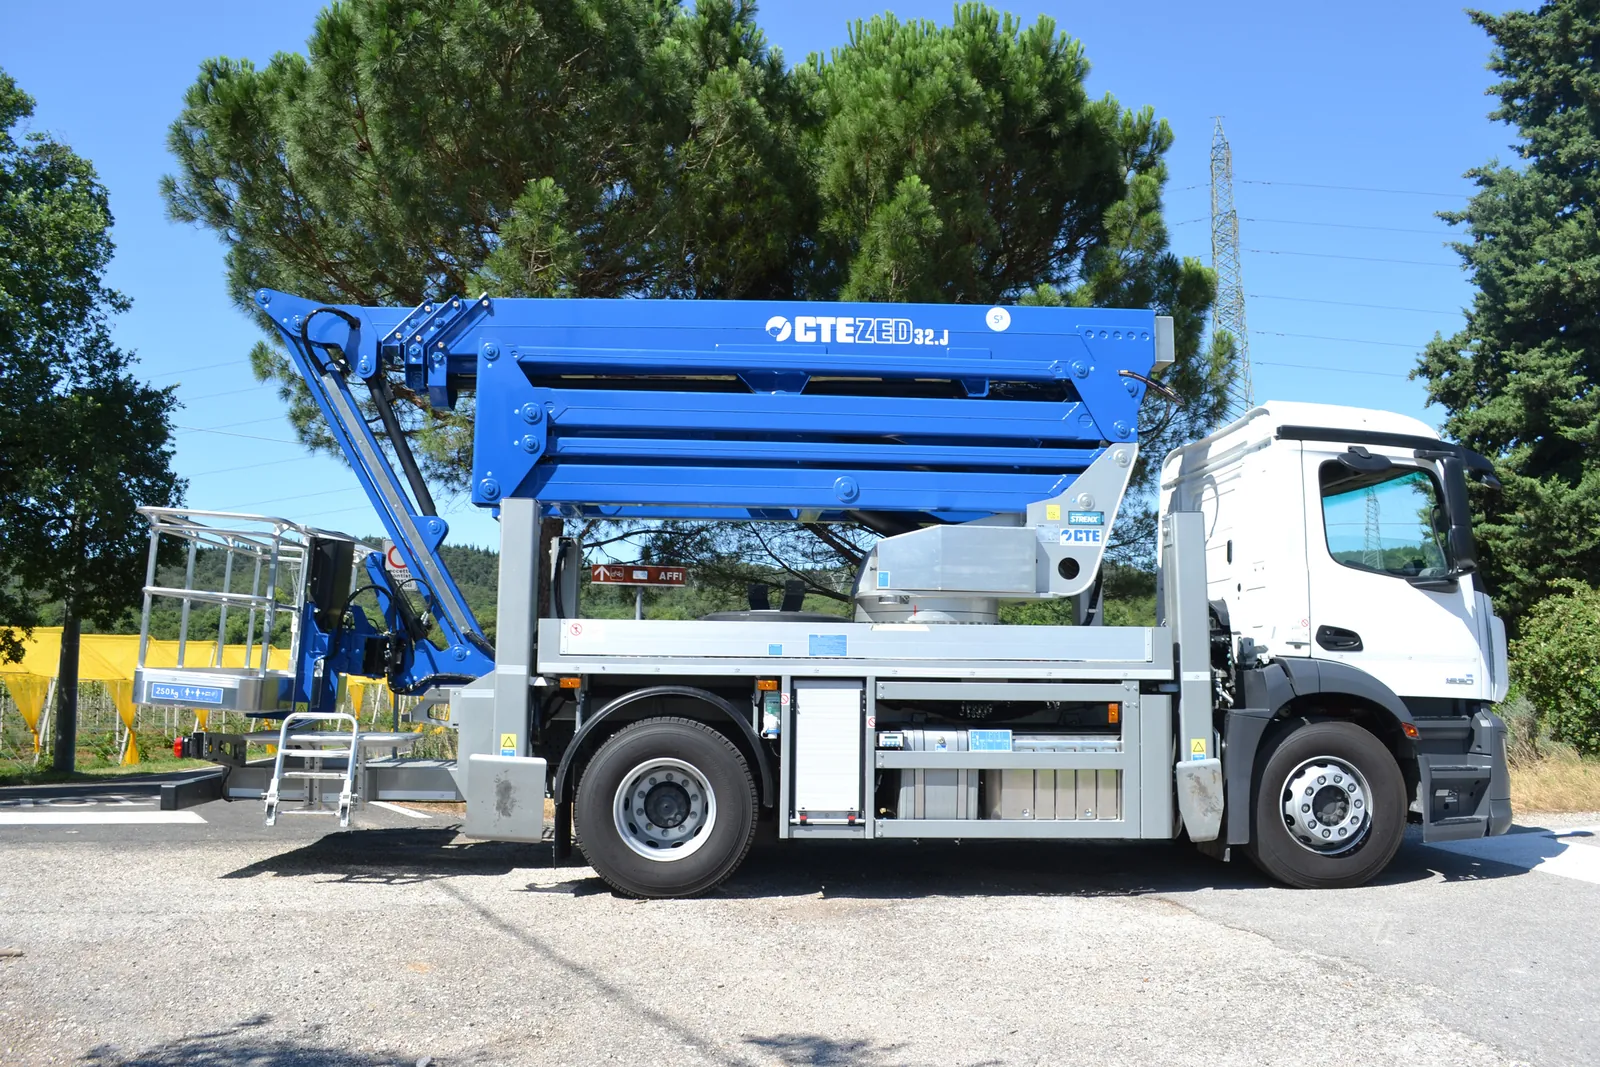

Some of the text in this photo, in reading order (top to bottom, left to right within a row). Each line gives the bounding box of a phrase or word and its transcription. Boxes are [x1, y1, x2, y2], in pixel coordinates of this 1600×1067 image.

[1070, 515, 1099, 523] STRENX
[1073, 529, 1100, 542] CTE
[658, 571, 683, 581] AFFI
